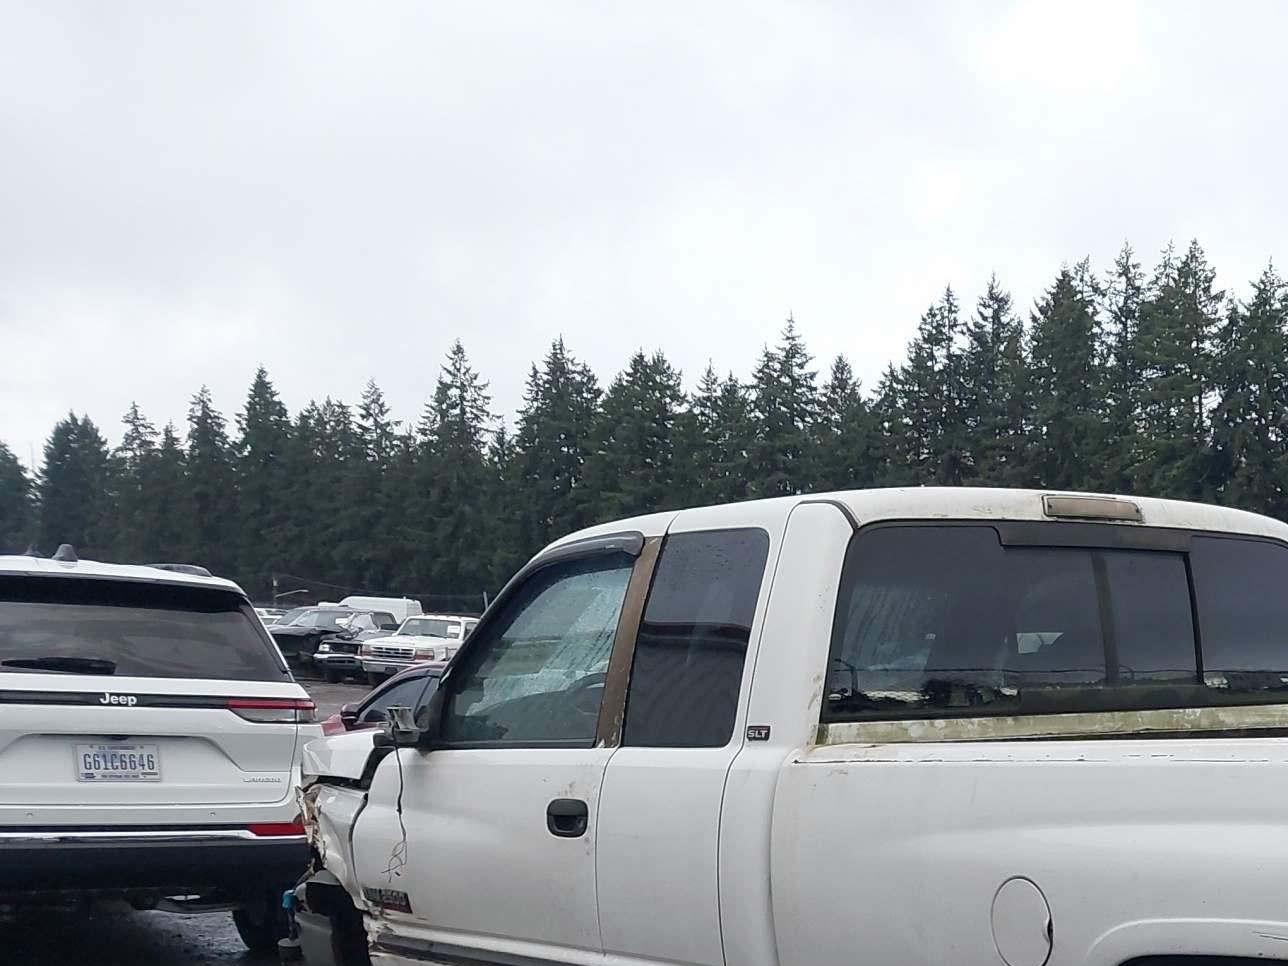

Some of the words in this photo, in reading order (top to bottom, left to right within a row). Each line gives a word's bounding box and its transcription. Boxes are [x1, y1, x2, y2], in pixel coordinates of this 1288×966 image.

[99, 692, 138, 706] Jeep
[748, 729, 768, 738] SLT
[83, 753, 155, 771] G61C6646
